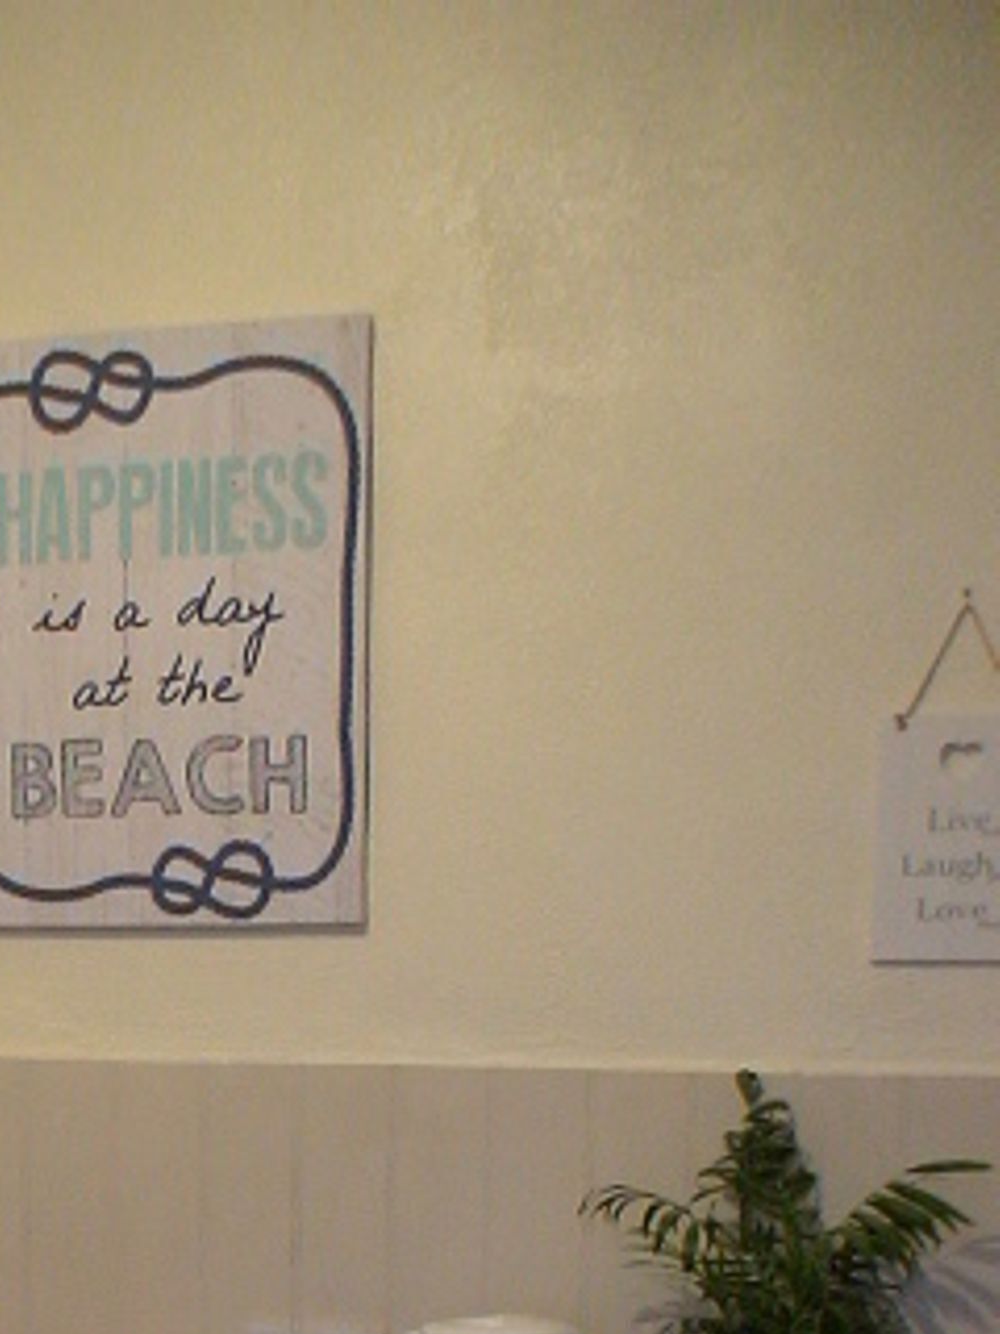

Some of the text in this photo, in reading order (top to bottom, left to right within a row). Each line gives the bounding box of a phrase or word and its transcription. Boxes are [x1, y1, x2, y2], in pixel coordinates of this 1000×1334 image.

[33, 577, 284, 676] is a day
[73, 655, 242, 709] at the
[10, 734, 308, 819] BEACH
